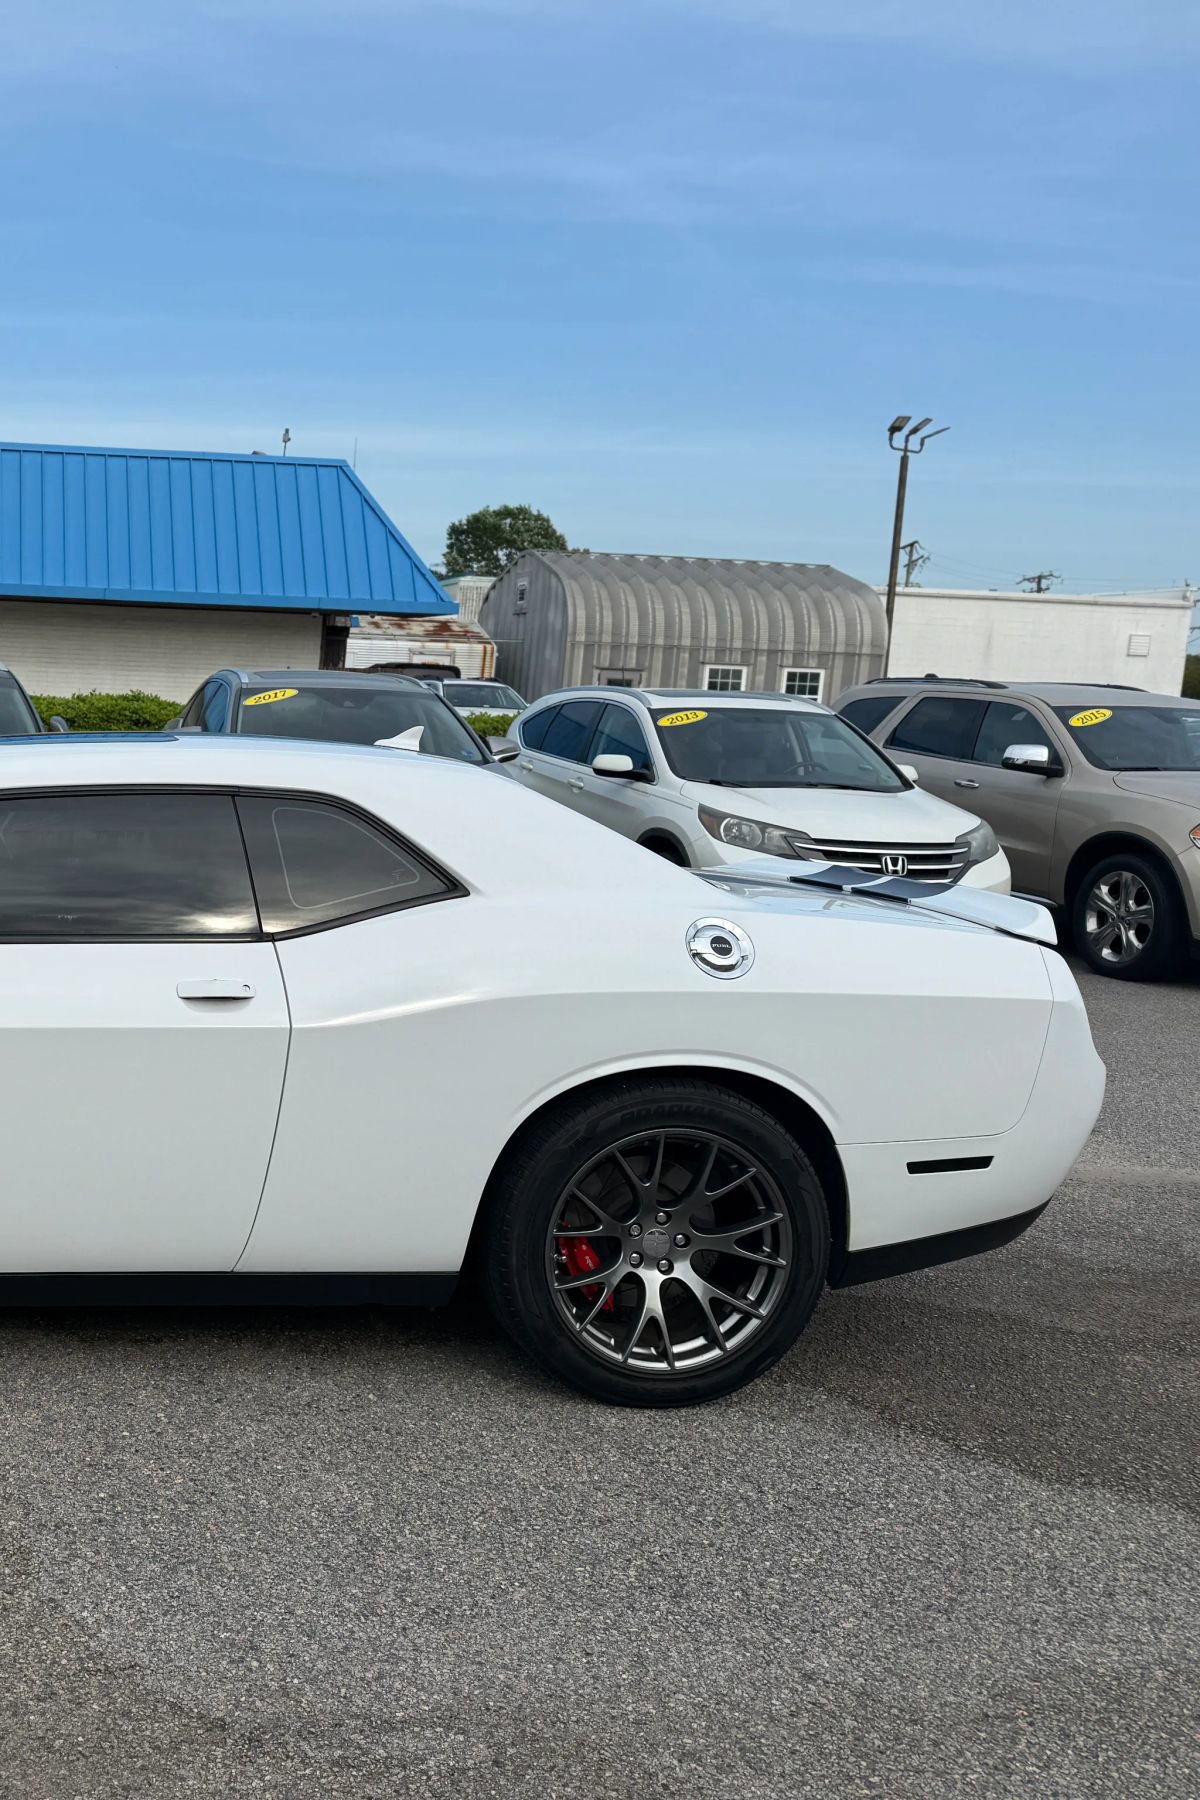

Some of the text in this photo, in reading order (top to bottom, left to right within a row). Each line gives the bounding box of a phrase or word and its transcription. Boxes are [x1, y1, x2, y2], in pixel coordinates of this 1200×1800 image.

[253, 690, 288, 704] 2017
[666, 711, 699, 725] 2013
[1076, 709, 1107, 726] 2015
